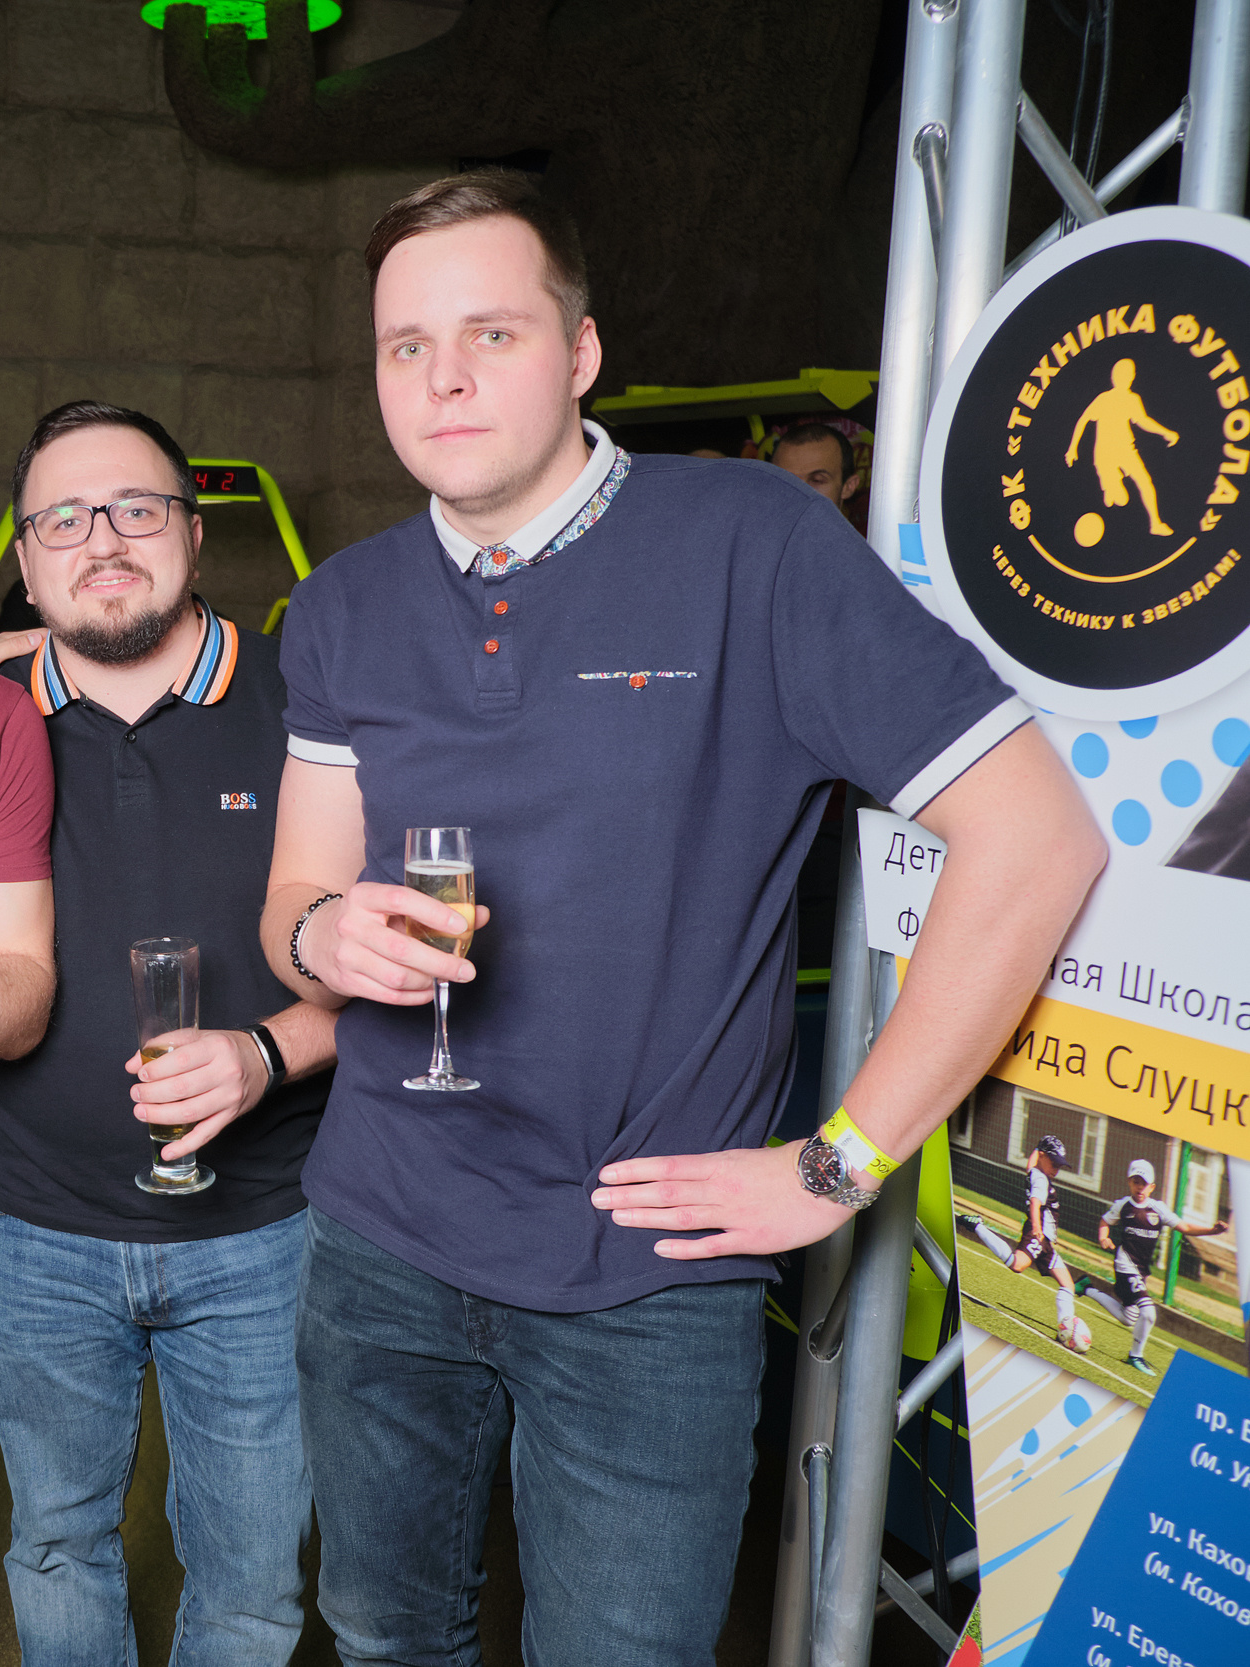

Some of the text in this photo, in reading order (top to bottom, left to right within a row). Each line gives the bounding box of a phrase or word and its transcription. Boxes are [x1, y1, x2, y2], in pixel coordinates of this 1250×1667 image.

[1001, 303, 1250, 533] ФК «ТЕХНИКА ФУТБОЛА»
[992, 544, 1243, 631] ЧЕРЕЗ ТЕХНИКУ К ЗВЕЗДАМ!
[220, 792, 257, 804] BOSS
[884, 832, 948, 875] Дет
[1119, 961, 1250, 1031] Школа
[1002, 1026, 1086, 1077] ида
[1196, 1403, 1234, 1434] пр.
[1190, 1442, 1222, 1475] (м.
[1149, 1512, 1181, 1542] ул.
[1144, 1551, 1174, 1584] (м.
[1091, 1606, 1195, 1667] ул. Ерев
